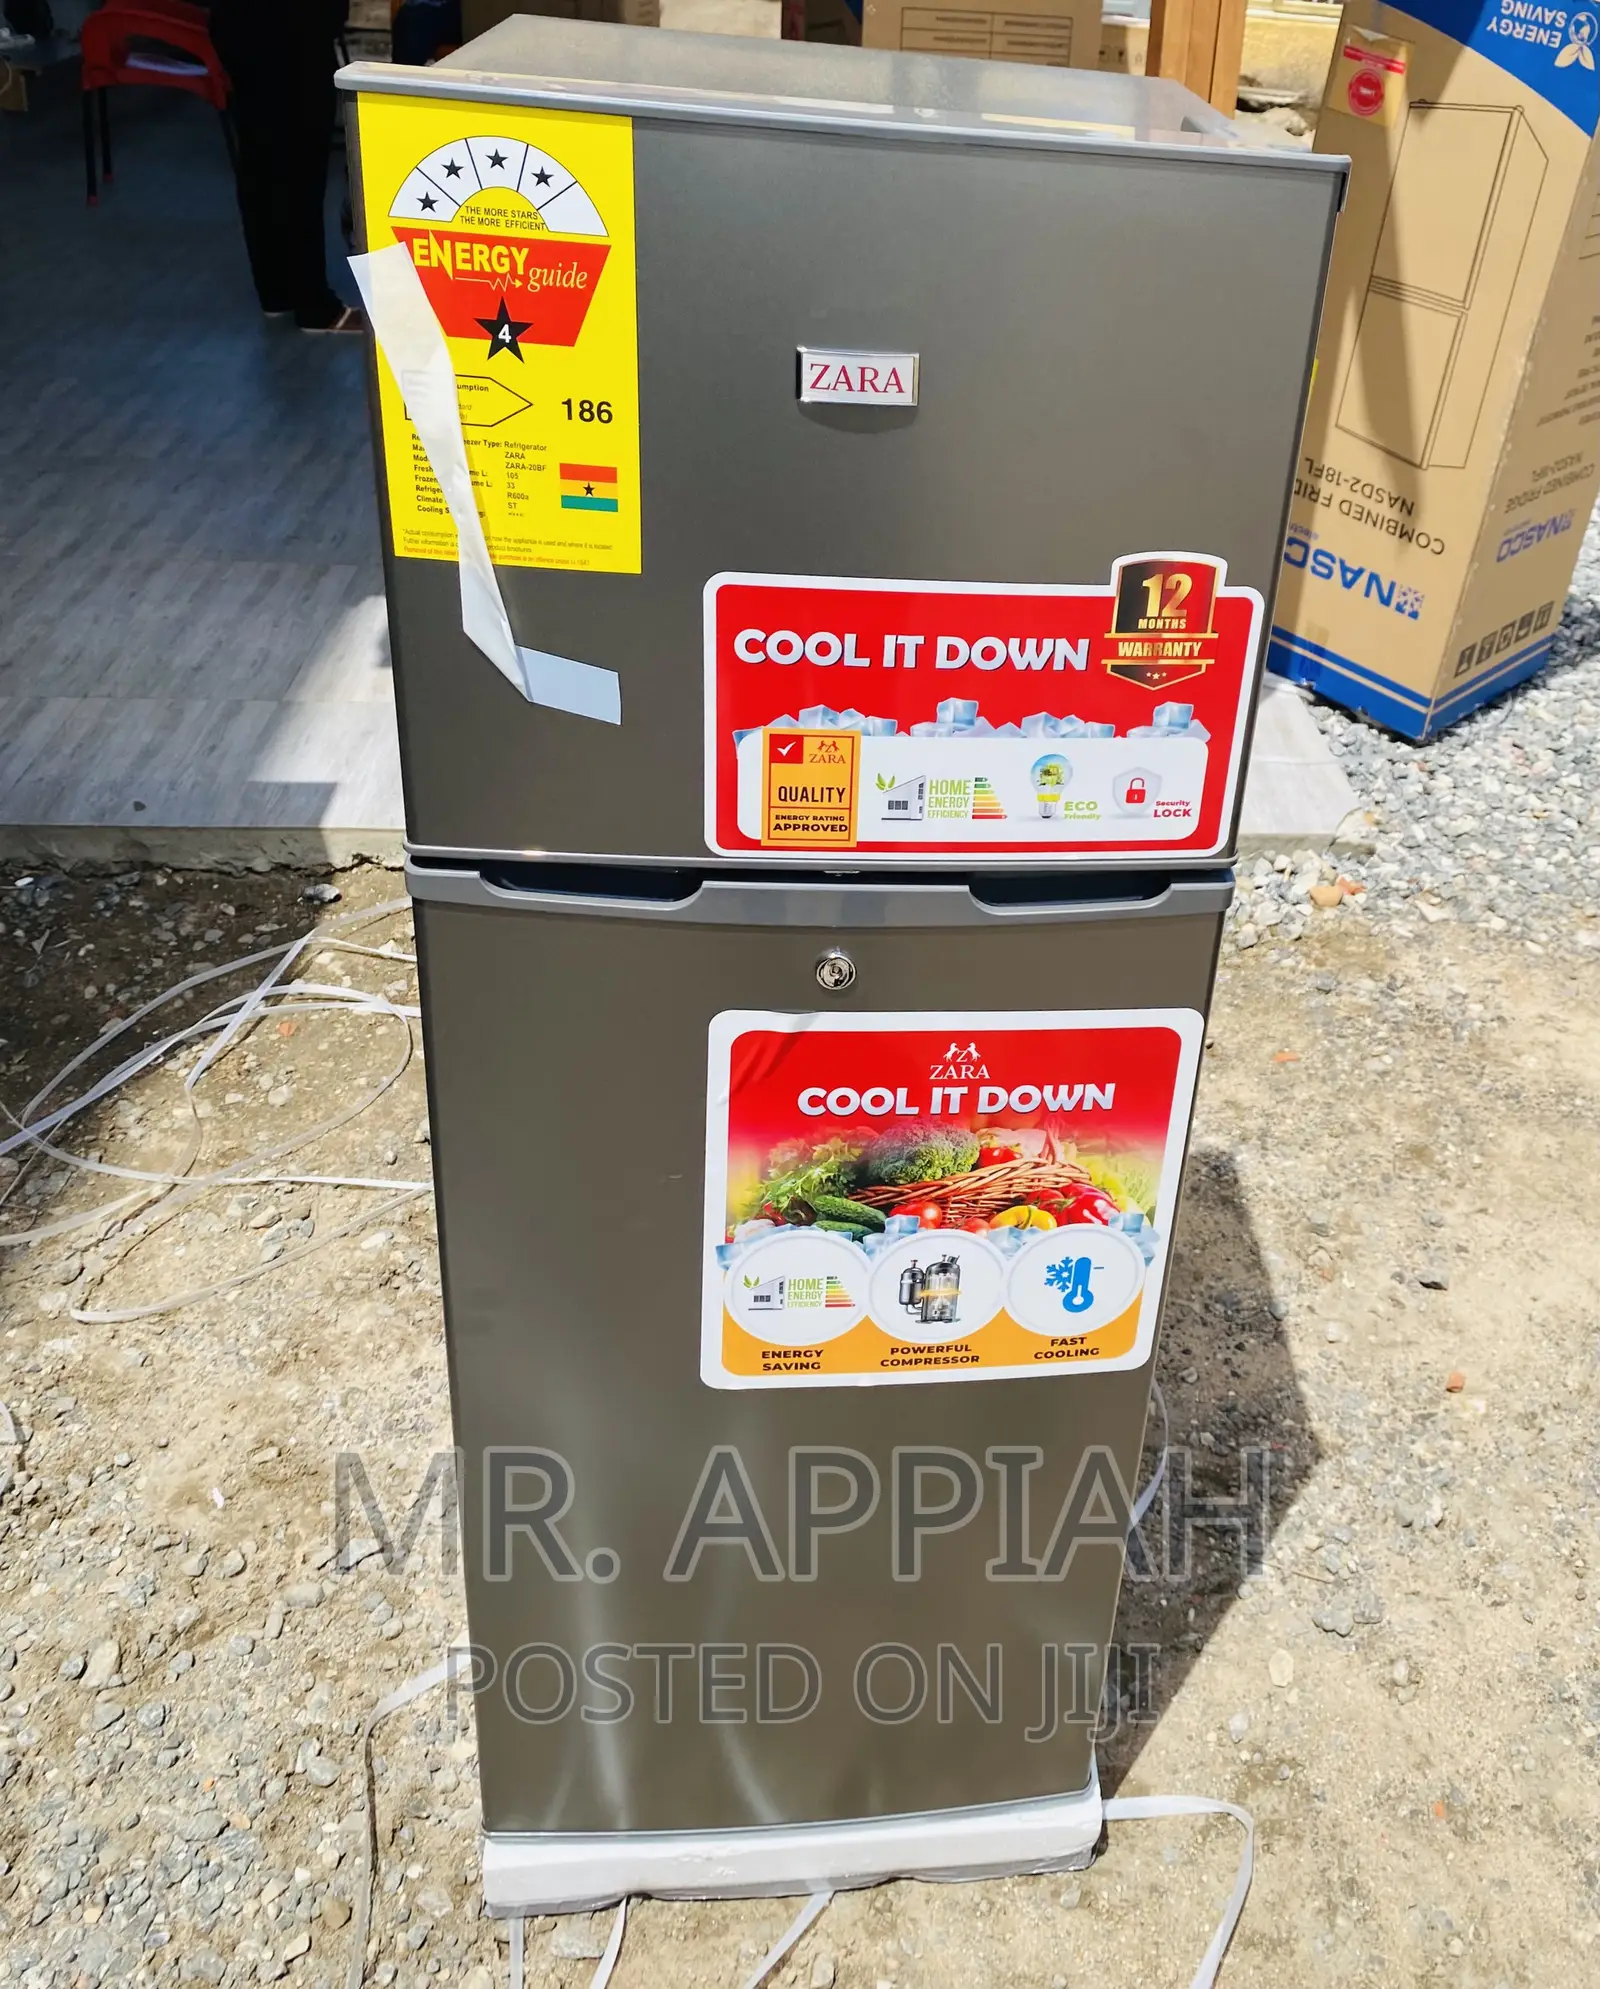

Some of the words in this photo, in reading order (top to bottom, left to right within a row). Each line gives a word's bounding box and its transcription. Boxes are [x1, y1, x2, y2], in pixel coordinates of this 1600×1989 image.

[1501, 0, 1568, 28] SAVING
[1486, 16, 1563, 48] ENERGY
[465, 205, 482, 215] THE
[483, 207, 509, 217] MORE
[511, 209, 538, 220] STARS
[460, 215, 475, 225] THE
[477, 217, 500, 227] MORE
[505, 219, 545, 231] EFFICIENT
[412, 229, 530, 280] ENERGY
[527, 262, 588, 292] guide
[498, 324, 512, 343] 4
[809, 363, 905, 394] ZARA
[561, 398, 613, 424] 186
[483, 439, 502, 449] Type:
[504, 441, 547, 451] Refrigerator
[505, 452, 525, 460] ZARA
[1305, 457, 1415, 517] NASD2-18FL
[416, 495, 443, 503] Climate
[417, 505, 443, 514] Cooling
[1339, 499, 1446, 556] COMBINED
[1496, 515, 1565, 563] NASCO
[1284, 536, 1397, 608] NASC
[1142, 573, 1193, 619] 12
[1137, 617, 1187, 630] MONTHS
[733, 628, 870, 667] COOL
[883, 635, 923, 669] IT
[935, 636, 1091, 671] DOWN
[1117, 641, 1203, 658] WARRANTY
[809, 753, 846, 764] ZARA
[928, 779, 972, 795] HOME
[778, 786, 846, 803] QUALITY
[928, 796, 970, 809] ENERGY
[1064, 801, 1098, 812] ECO
[1155, 800, 1190, 808] Security
[775, 814, 809, 822] ENERGY
[812, 814, 845, 822] RATING
[927, 809, 969, 819] EFFICIENCY
[1064, 812, 1101, 821] Friendly
[1153, 808, 1192, 818] LOCK
[773, 823, 849, 833] APPROVED
[929, 1064, 991, 1080] ZARA
[797, 1086, 919, 1116] COOL
[930, 1086, 968, 1114] IT
[977, 1082, 1116, 1114] DOWN
[788, 1278, 824, 1291] HOME
[788, 1291, 823, 1301] ENERGY
[1049, 1336, 1087, 1347] FAST
[761, 1349, 824, 1360] ENERGY
[890, 1344, 973, 1356] POWERFUL
[1034, 1346, 1100, 1361] COOLING
[762, 1360, 821, 1371] SAVING
[880, 1354, 980, 1367] COMPRESSOR
